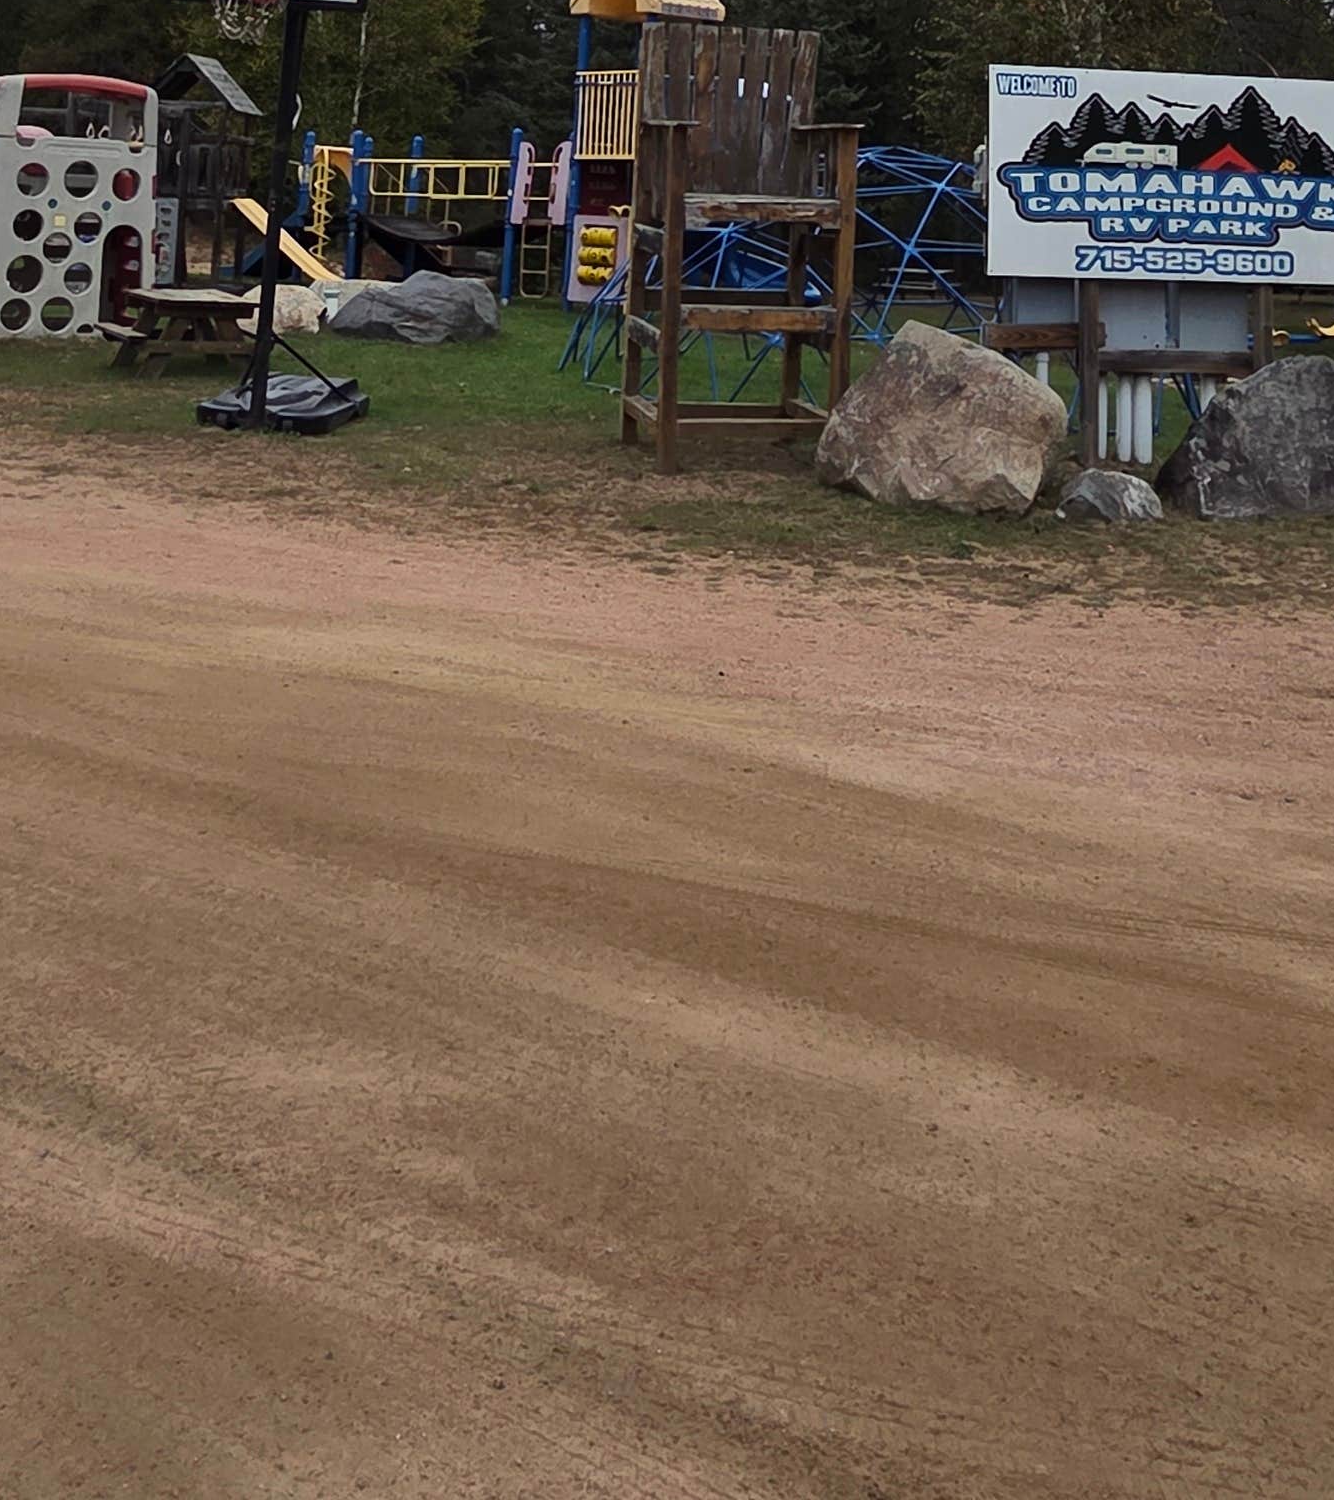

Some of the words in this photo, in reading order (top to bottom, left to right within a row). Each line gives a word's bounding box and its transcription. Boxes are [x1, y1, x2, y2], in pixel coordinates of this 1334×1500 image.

[997, 74, 1058, 96] WELCOME
[1059, 76, 1076, 97] TO
[1028, 197, 1298, 218] CAMPGROUND
[1101, 217, 1154, 232] RV
[1168, 218, 1267, 237] PARK
[1077, 248, 1292, 274] 715-525-9600
